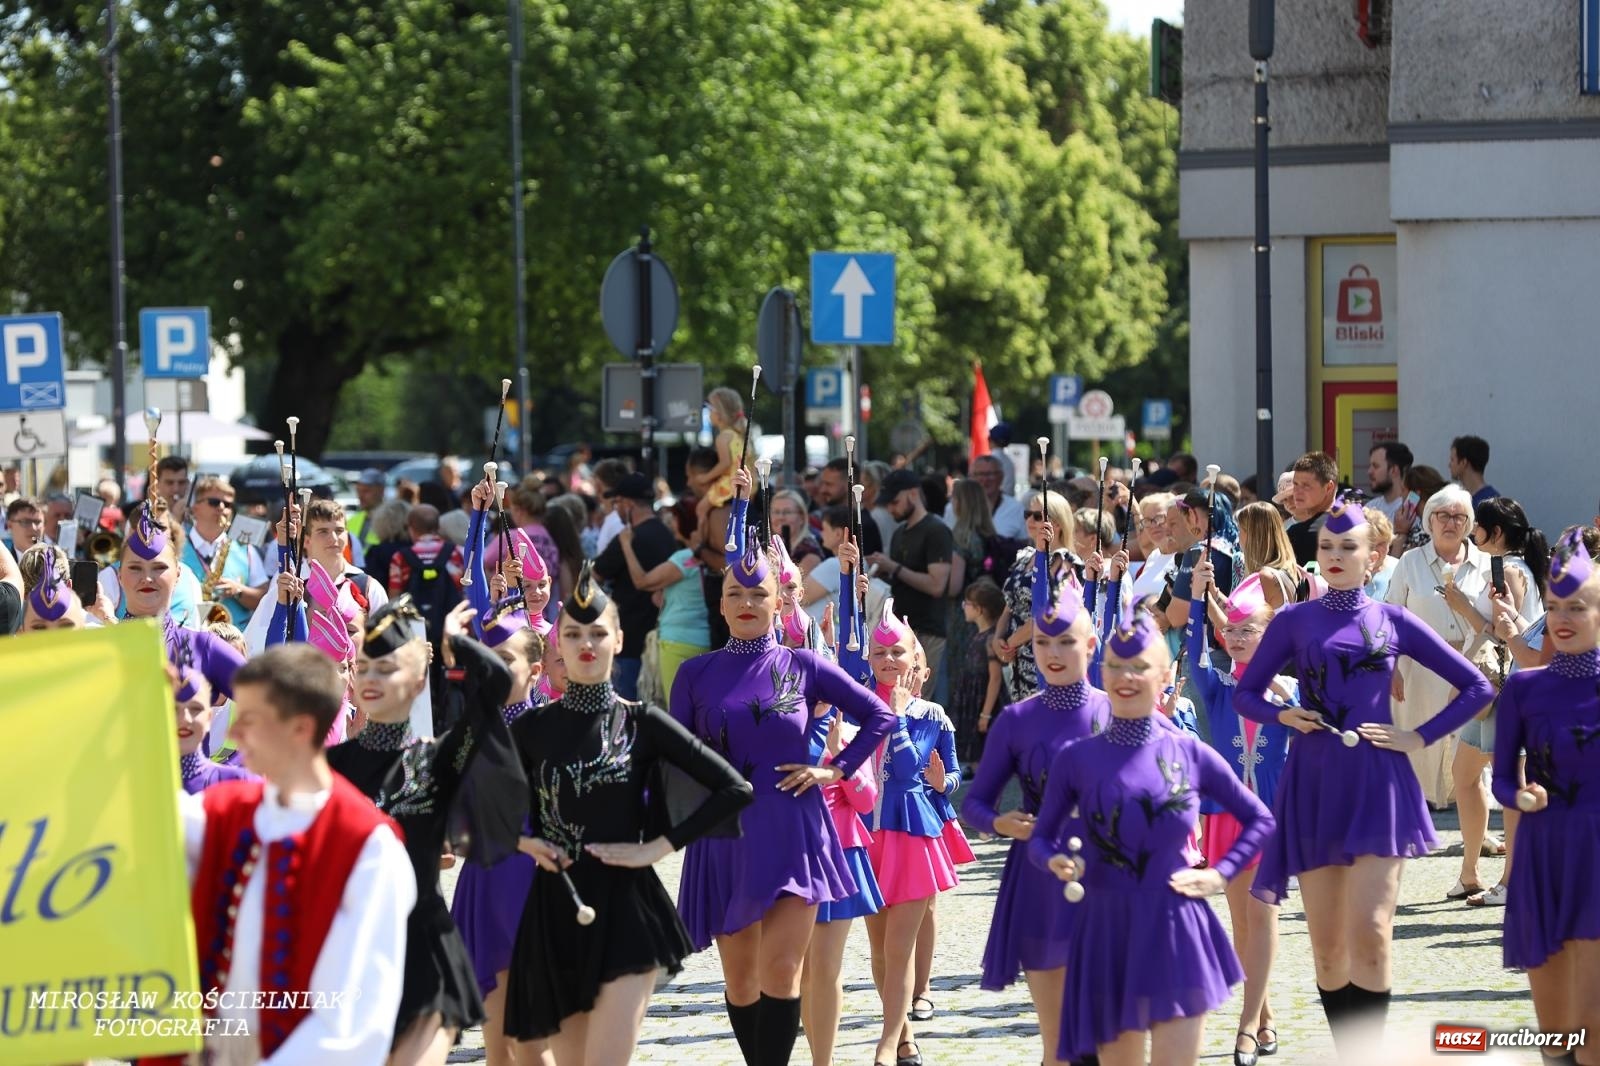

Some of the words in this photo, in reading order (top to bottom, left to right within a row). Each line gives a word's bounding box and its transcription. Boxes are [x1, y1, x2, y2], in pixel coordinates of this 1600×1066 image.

[4, 323, 47, 384] P
[156, 316, 196, 370] P
[1335, 325, 1384, 341] Bliski
[815, 371, 838, 404] P
[1055, 377, 1077, 404] P
[0, 815, 117, 926] ło
